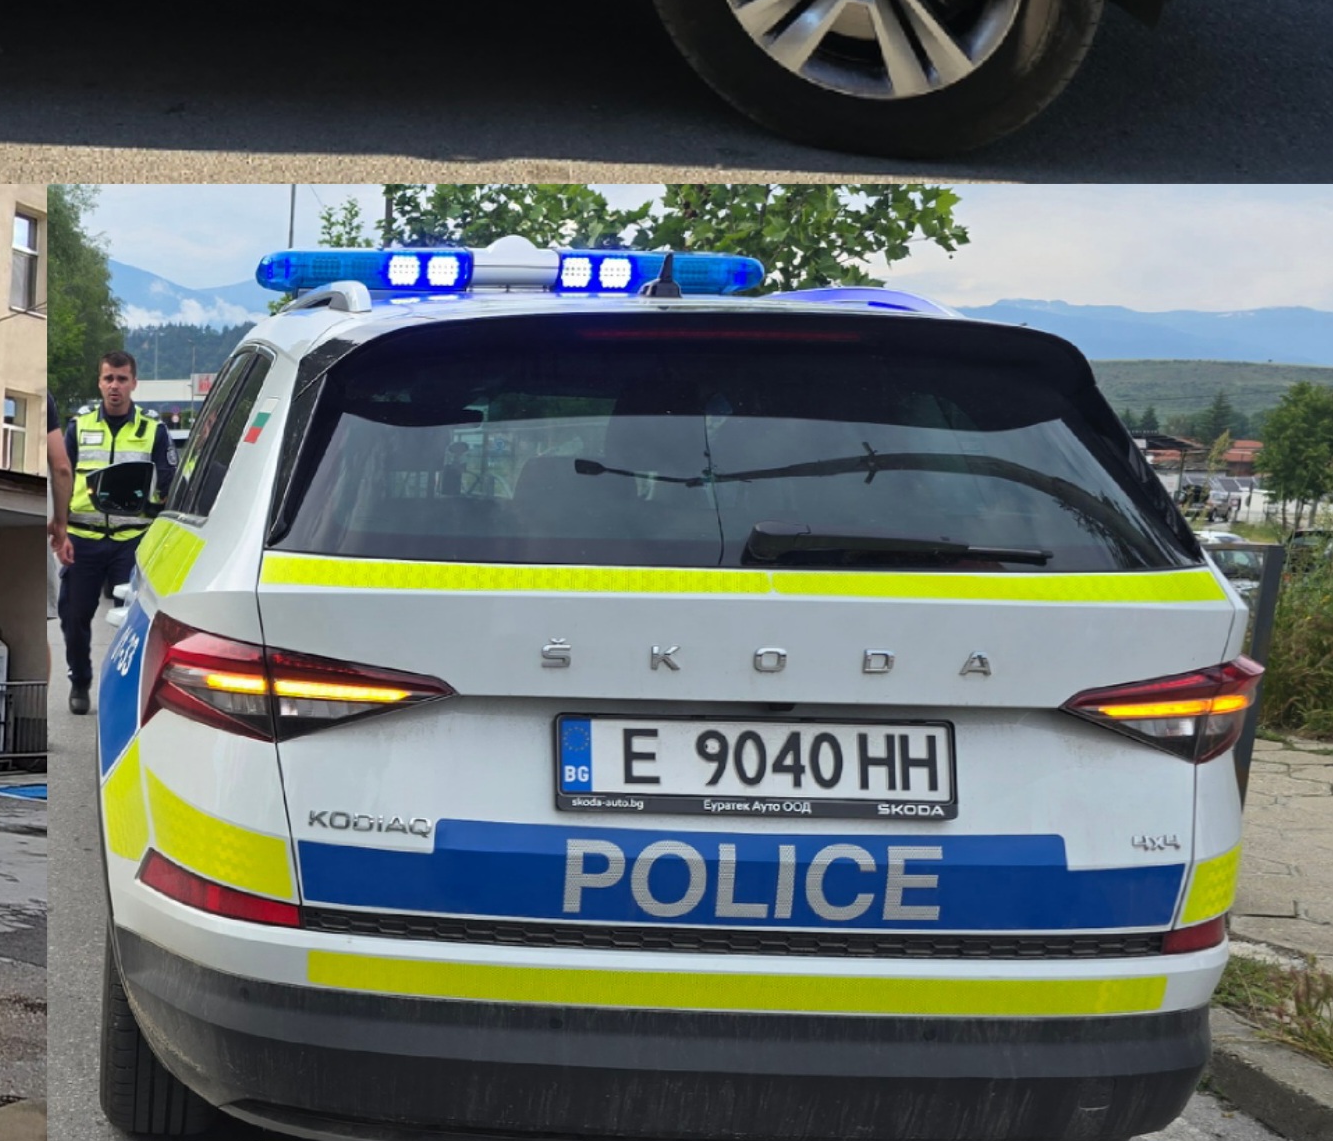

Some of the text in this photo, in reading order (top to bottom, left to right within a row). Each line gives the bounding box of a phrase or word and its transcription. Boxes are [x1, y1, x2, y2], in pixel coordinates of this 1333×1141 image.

[623, 728, 660, 784] E
[695, 730, 843, 789] 9040
[564, 765, 589, 782] BG
[571, 798, 644, 811] skoda-auto.bg
[703, 799, 812, 815] Еуратек Ауто ООД
[308, 810, 432, 839] KODIAQ
[563, 839, 943, 921] POLICE
